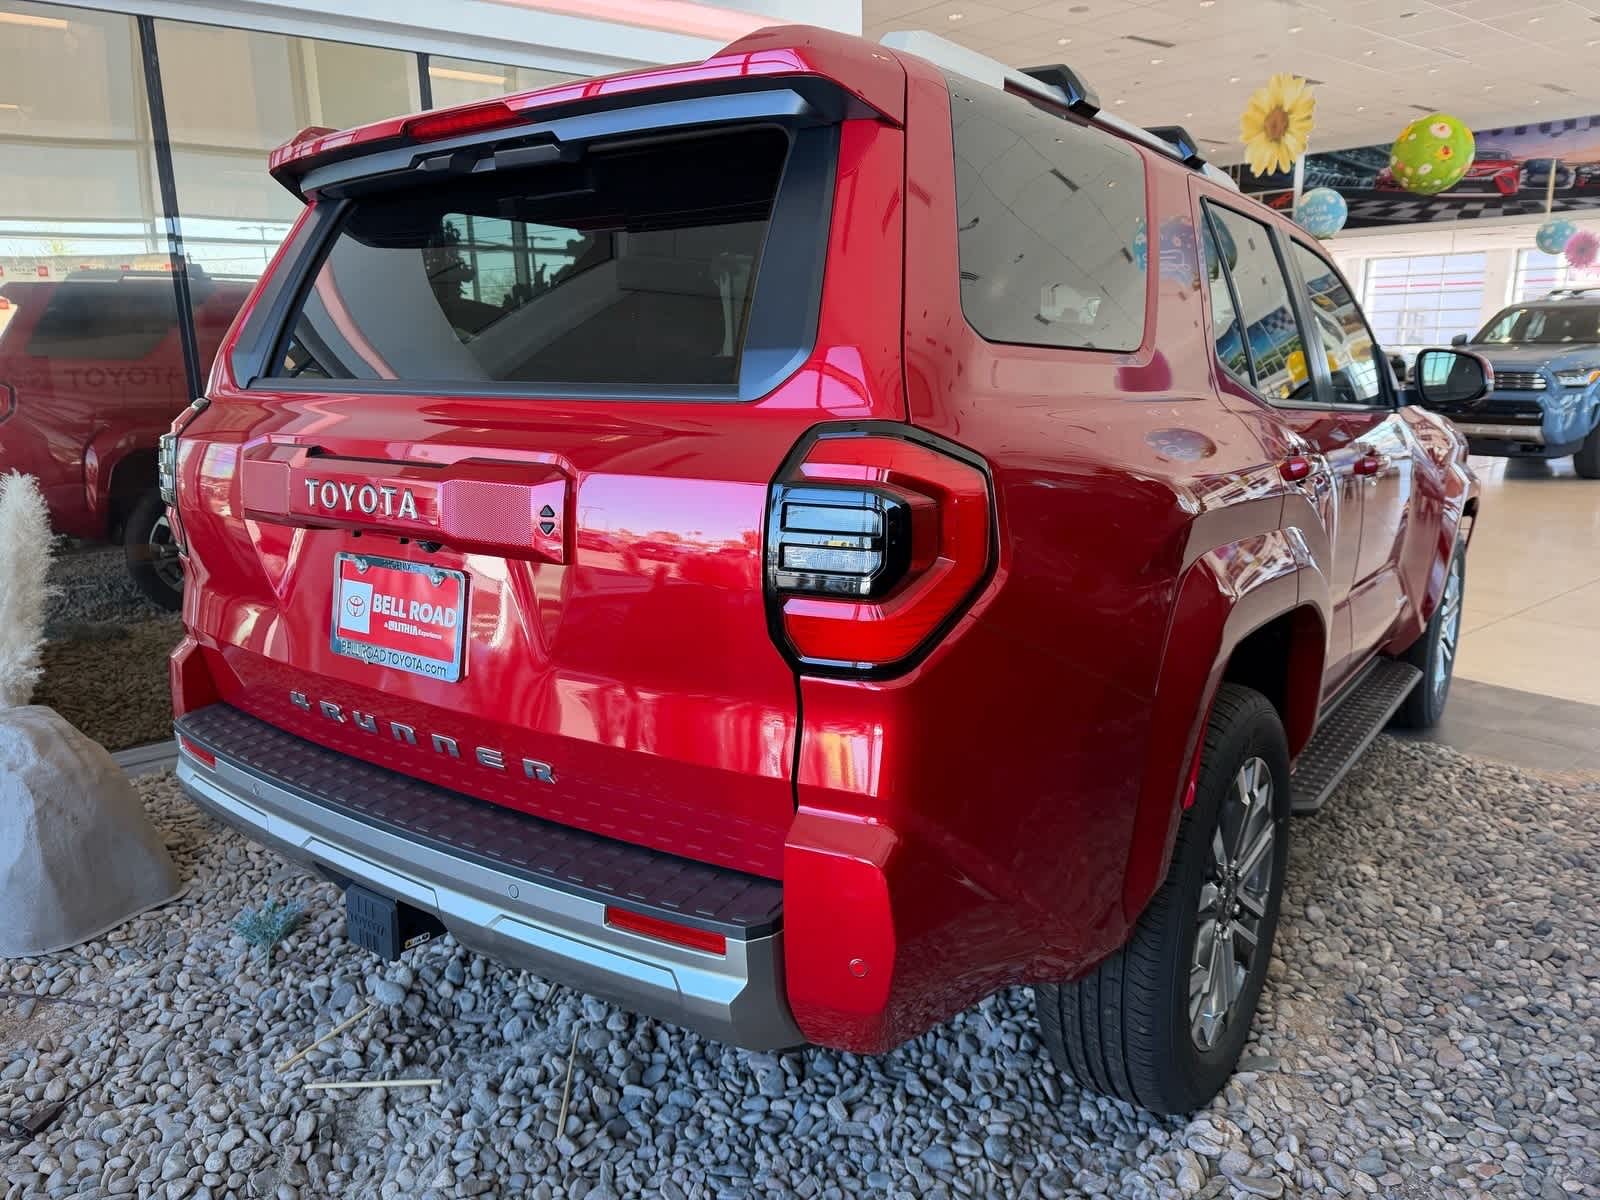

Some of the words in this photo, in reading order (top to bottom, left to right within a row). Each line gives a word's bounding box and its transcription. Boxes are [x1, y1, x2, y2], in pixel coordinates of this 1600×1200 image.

[304, 478, 419, 520] TOYOTA
[372, 593, 407, 619] BELL
[409, 600, 457, 628] ROAD
